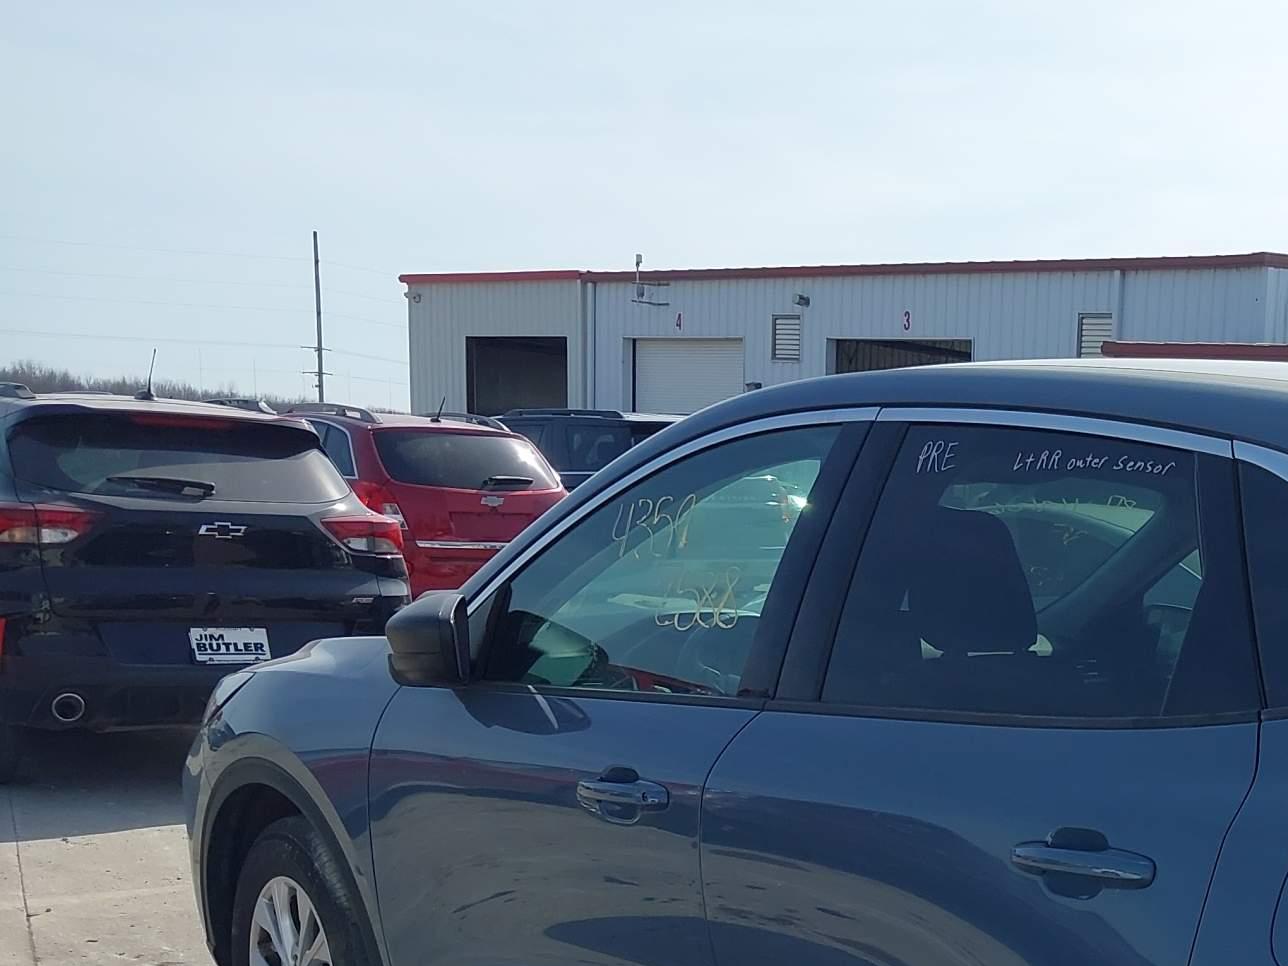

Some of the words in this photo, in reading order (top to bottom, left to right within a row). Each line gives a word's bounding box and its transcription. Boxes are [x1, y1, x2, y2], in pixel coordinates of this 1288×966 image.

[675, 313, 682, 330] 4
[903, 311, 911, 330] 3
[916, 440, 959, 472] PRE
[1067, 452, 1109, 470] outer
[194, 633, 225, 642] JIM
[195, 642, 266, 653] BUTLER
